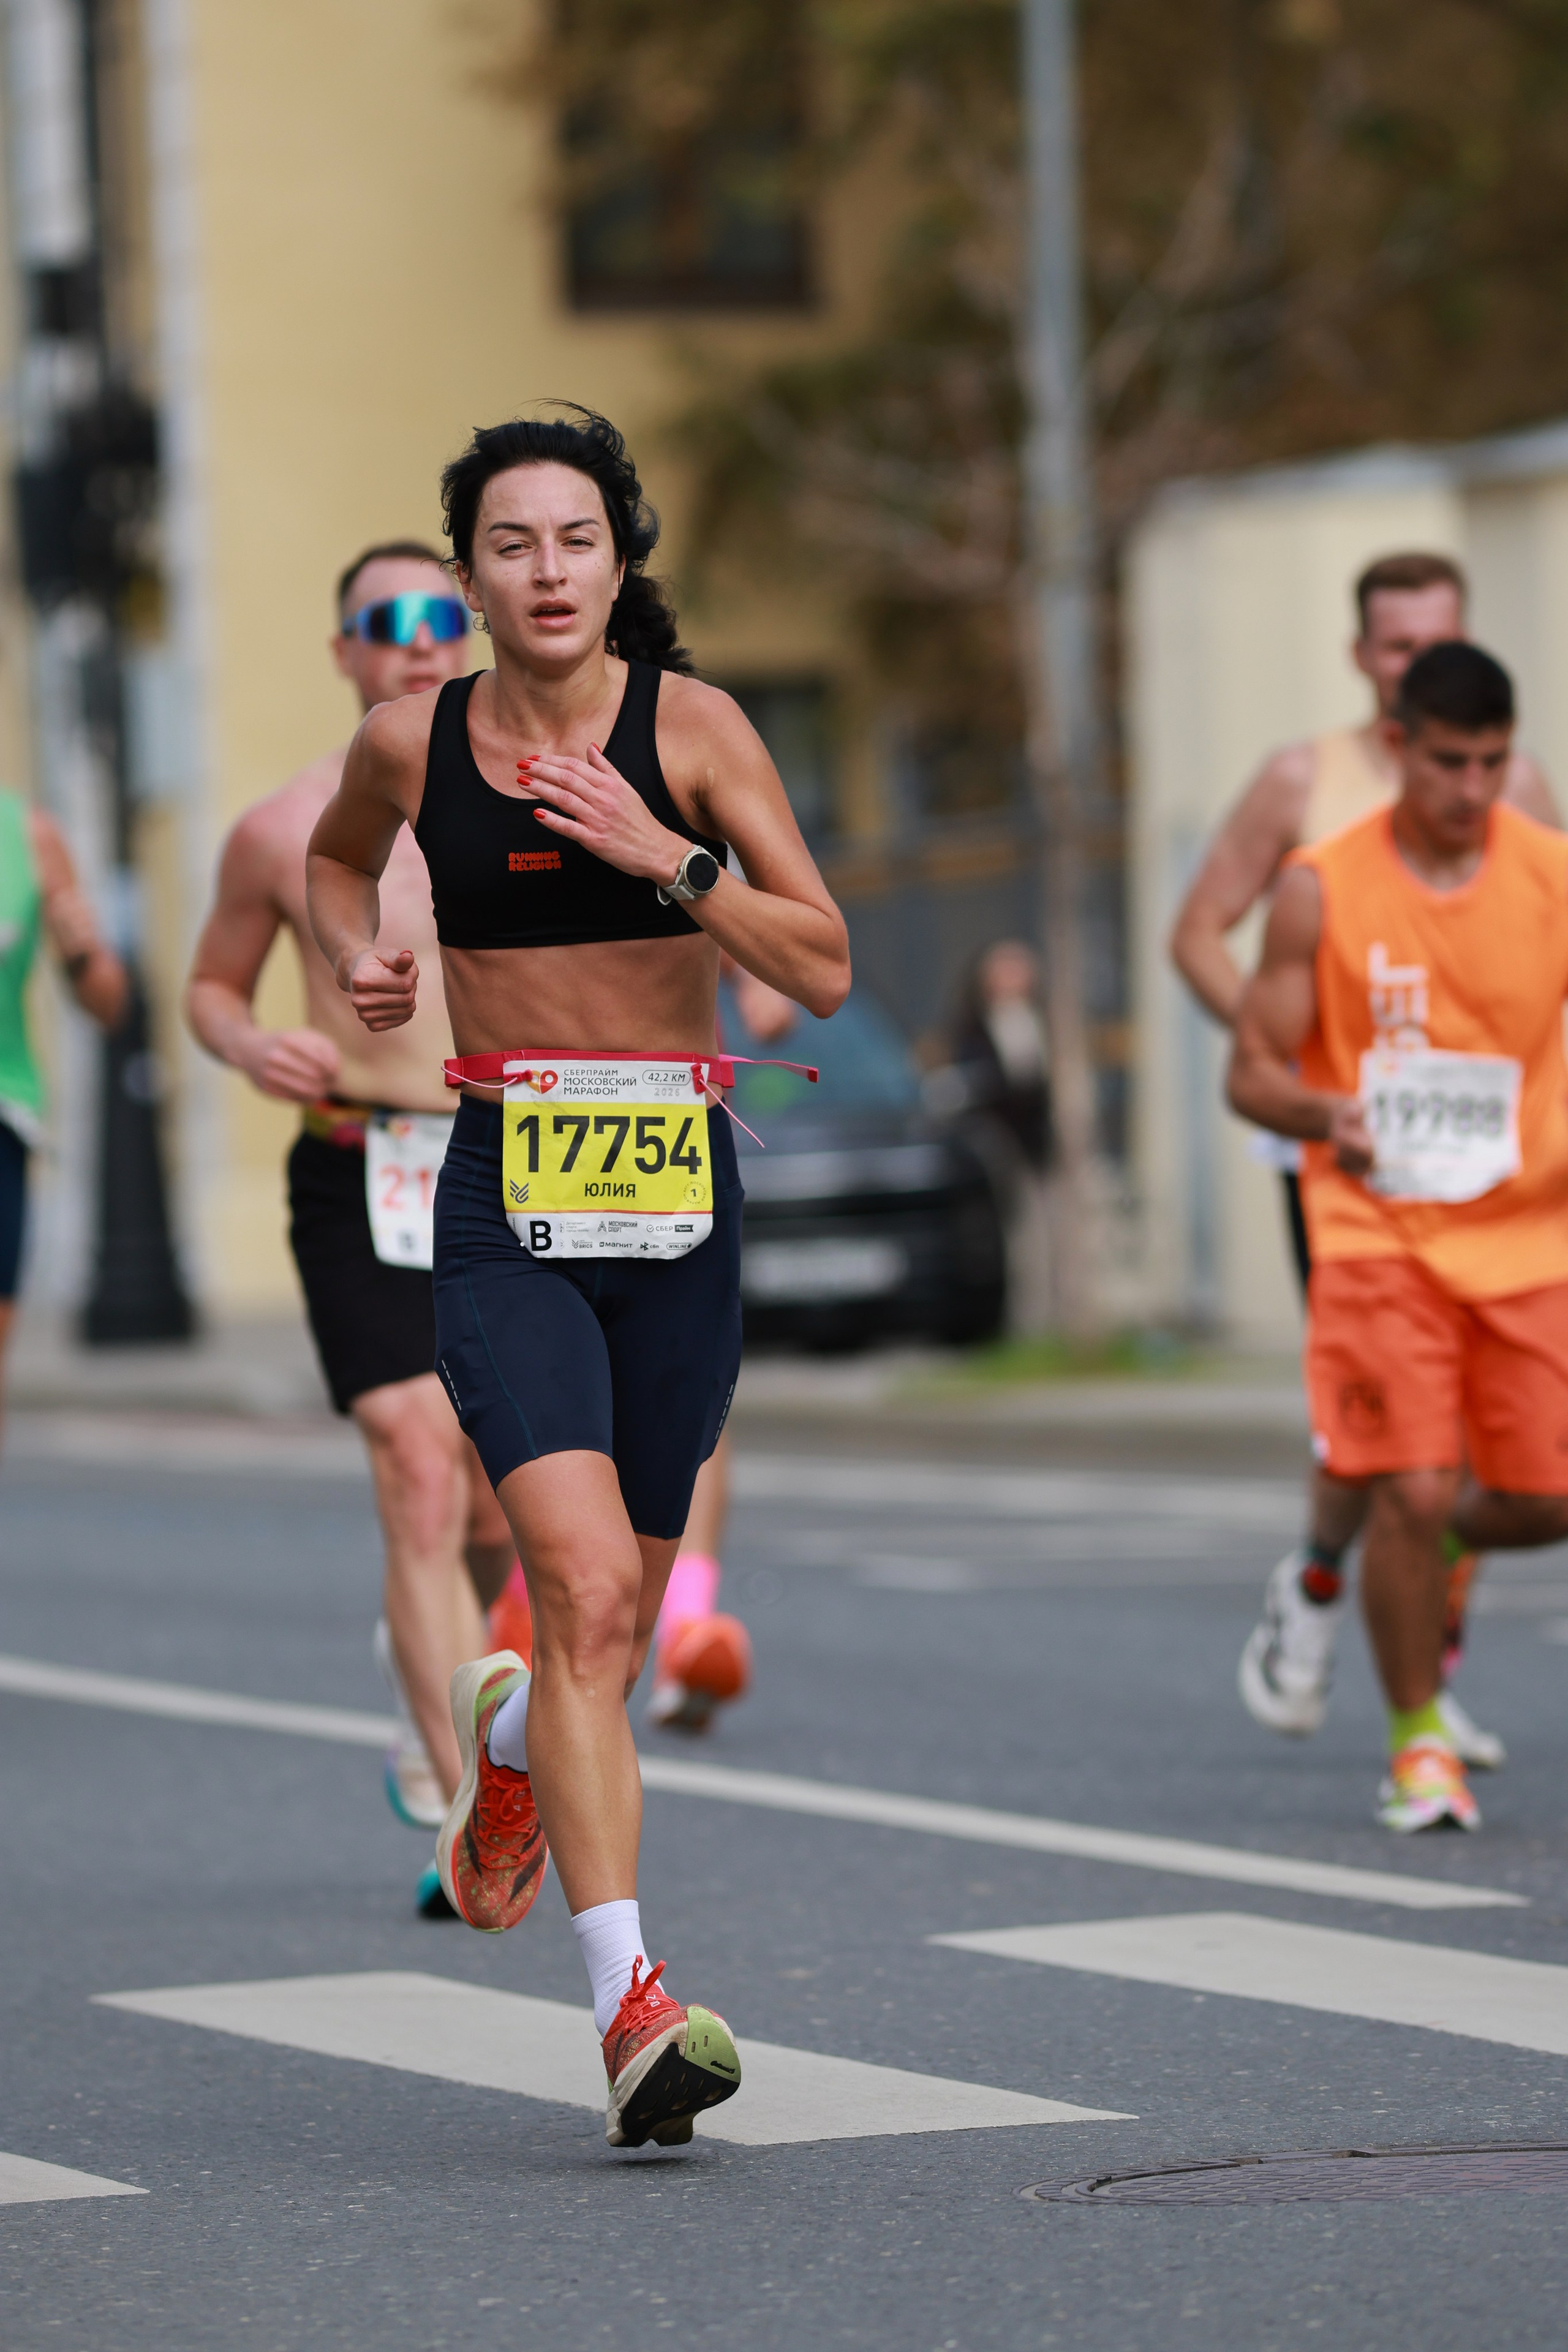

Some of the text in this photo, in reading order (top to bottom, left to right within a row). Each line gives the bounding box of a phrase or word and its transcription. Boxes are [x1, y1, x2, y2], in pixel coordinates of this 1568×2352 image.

[508, 851, 560, 862] RUNNING
[508, 860, 562, 872] RELIGION
[564, 1076, 636, 1086] МОСКОВСКИЙ
[648, 1072, 668, 1082] 42,2
[516, 1115, 702, 1175] 17754
[379, 1164, 431, 1210] 21
[584, 1183, 636, 1198] ЮЛИЯ
[690, 1188, 696, 1197] 1
